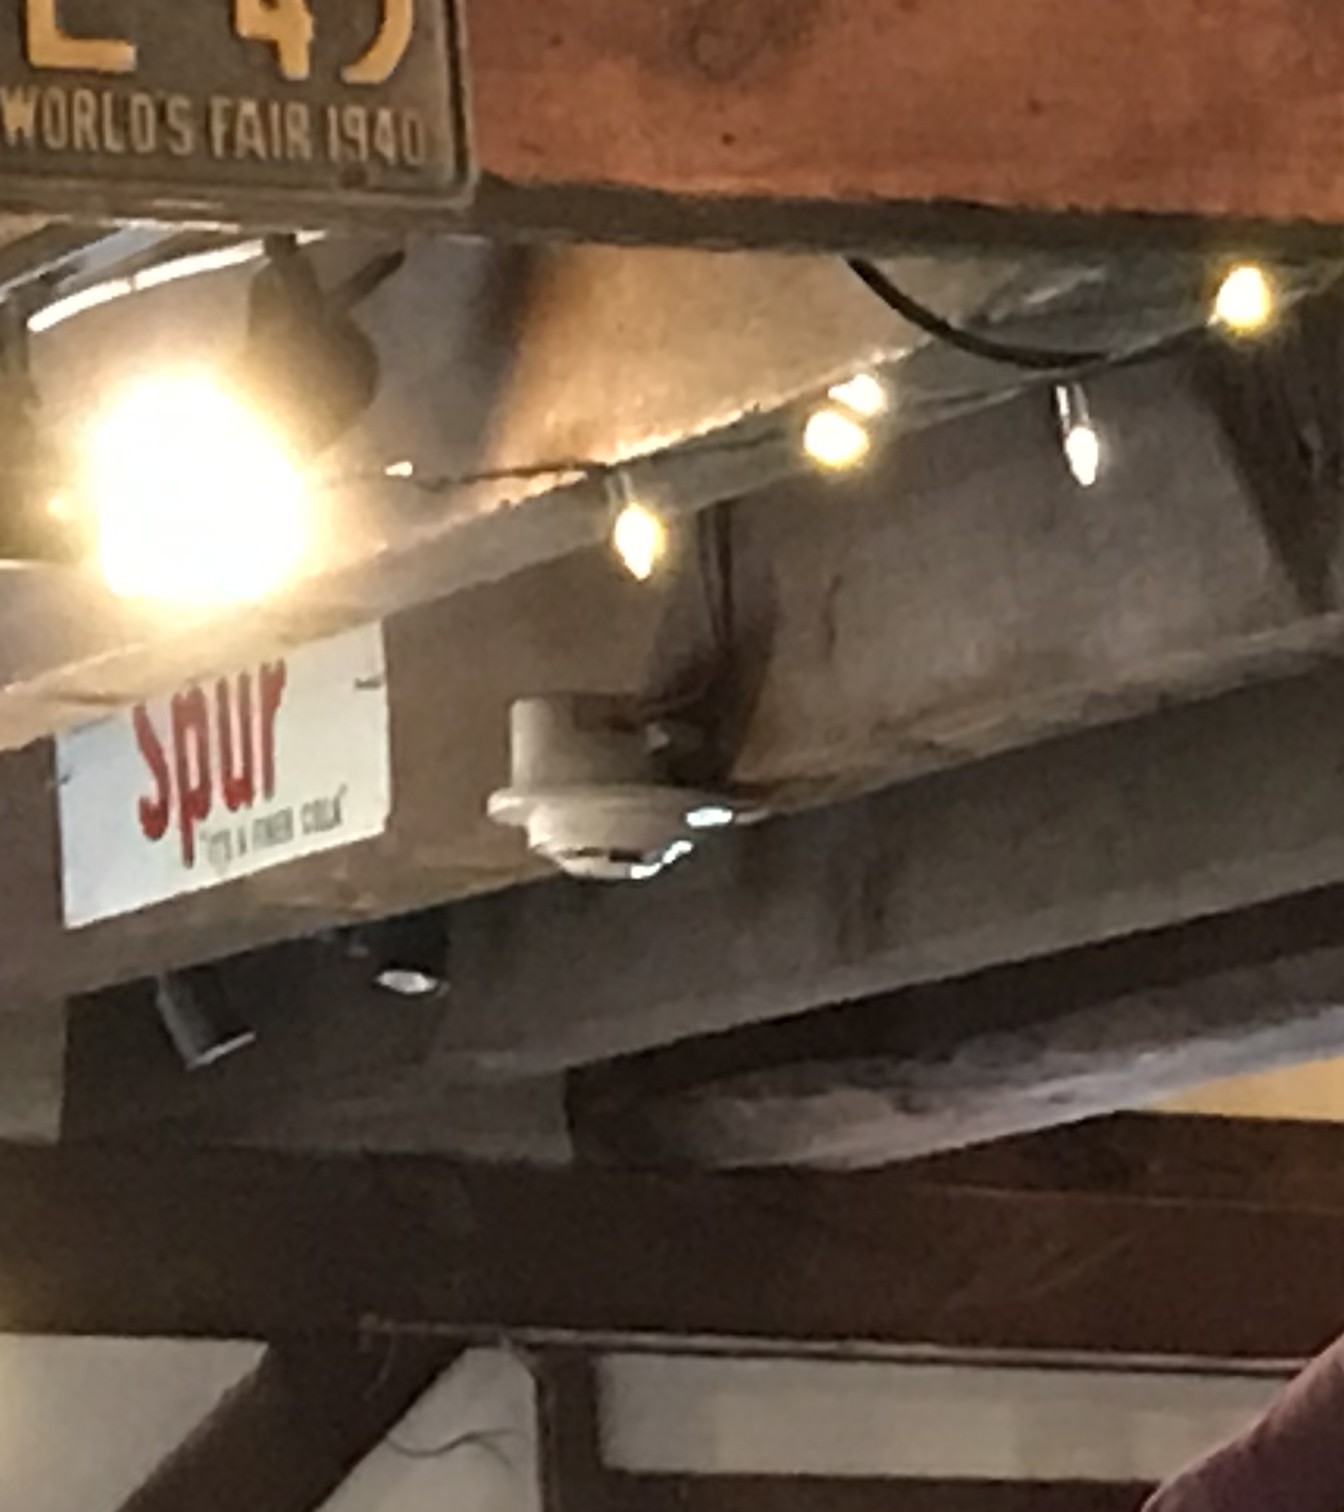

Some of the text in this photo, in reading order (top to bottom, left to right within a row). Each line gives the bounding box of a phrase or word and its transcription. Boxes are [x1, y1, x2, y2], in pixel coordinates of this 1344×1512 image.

[0, 84, 427, 167] WORLD'S FAIR 1940
